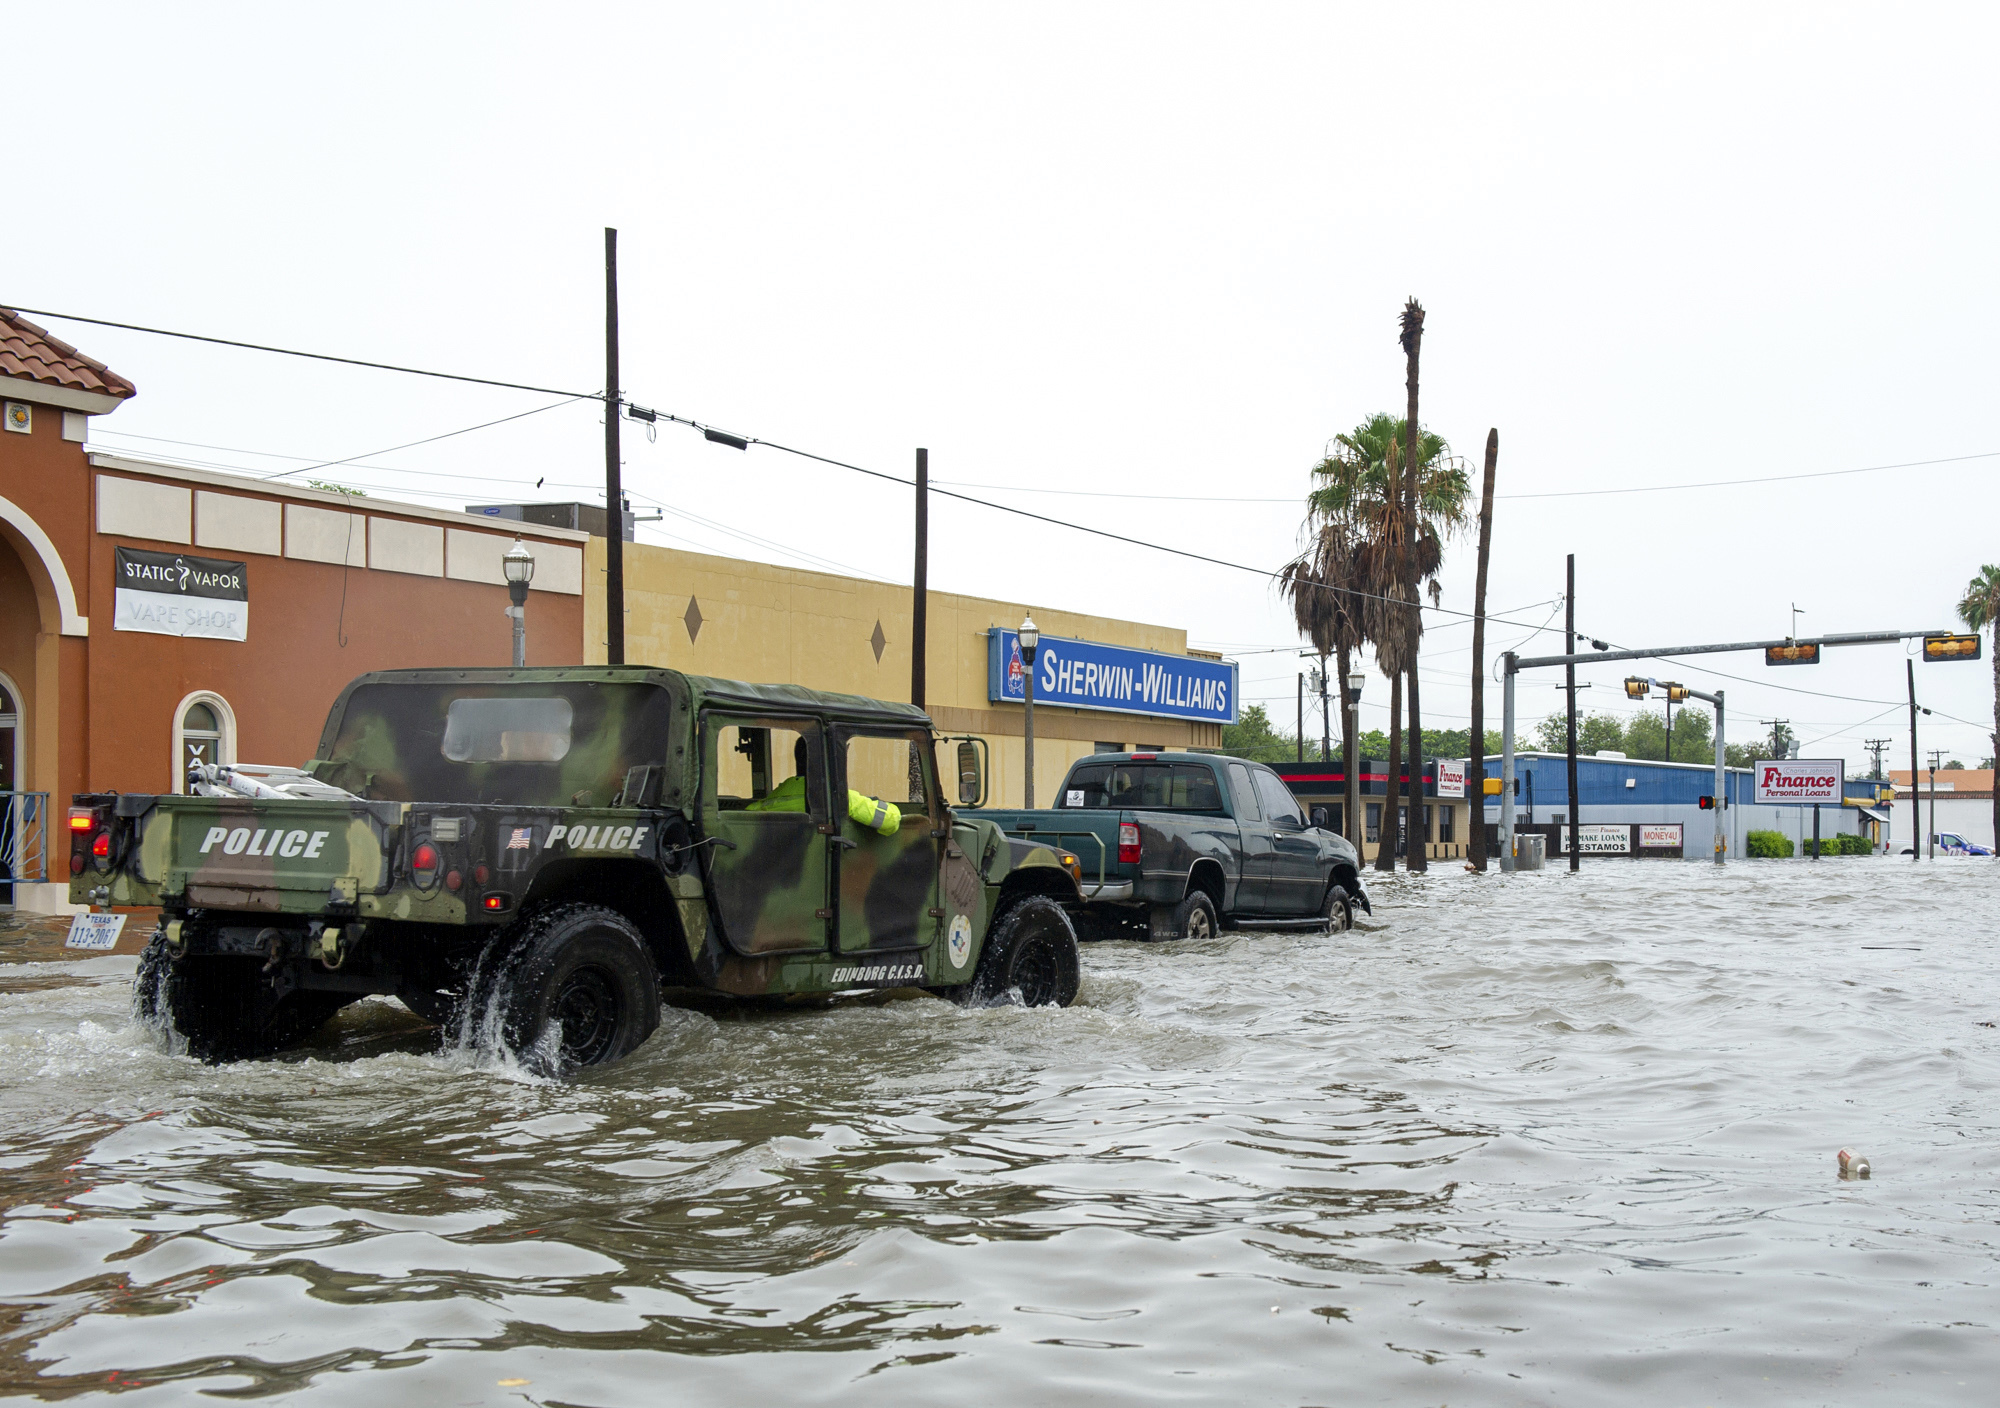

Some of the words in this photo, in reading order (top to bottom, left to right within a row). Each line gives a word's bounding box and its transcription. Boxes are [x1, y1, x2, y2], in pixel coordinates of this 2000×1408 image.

[126, 562, 175, 582] STATIC
[192, 571, 241, 589] VAPOR
[129, 601, 179, 624] VAPE
[184, 607, 237, 629] SHOP
[1041, 649, 1227, 712] SHERWIN-WILLIAMS
[1761, 767, 1836, 788] Finance
[1765, 789, 1803, 797] Personal
[1805, 789, 1831, 797] Loans
[199, 827, 330, 858] POLICE
[543, 825, 649, 850] POLICE
[1643, 831, 1678, 840] MONEY4U
[90, 916, 111, 924] TEXAS
[831, 965, 887, 983] EDINBURG
